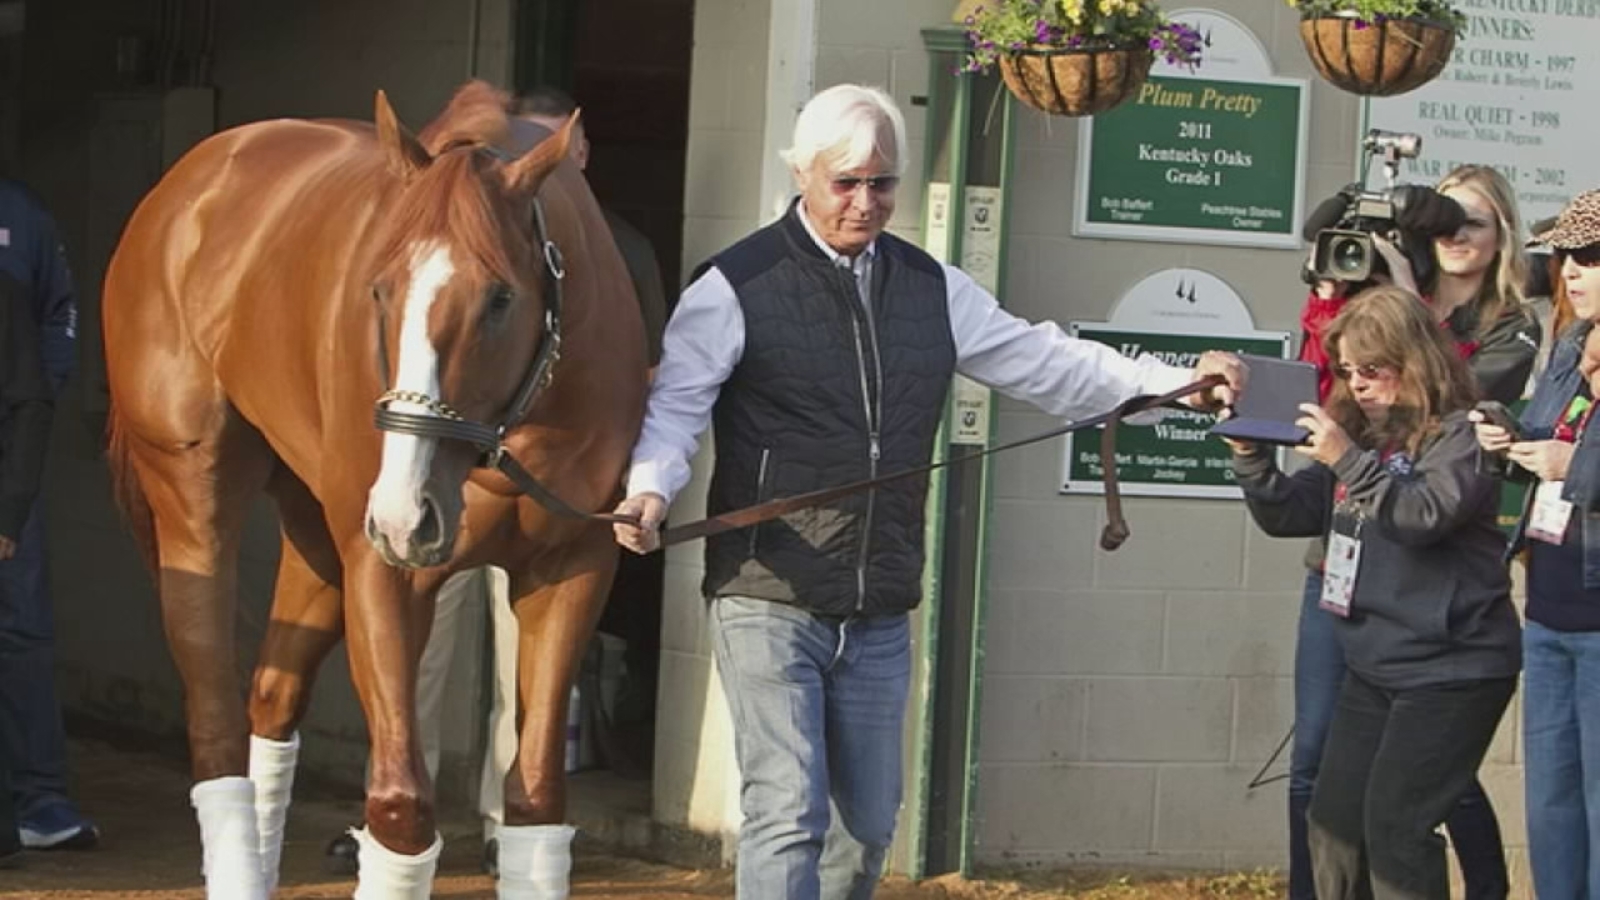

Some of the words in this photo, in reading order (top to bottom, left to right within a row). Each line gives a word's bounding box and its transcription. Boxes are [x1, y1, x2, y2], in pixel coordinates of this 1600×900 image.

[1554, 0, 1600, 18] DERB
[1470, 16, 1536, 41] INNERS:
[1469, 49, 1529, 69] CHARM
[1547, 55, 1576, 72] 1997
[1137, 83, 1194, 108] Plum
[1200, 87, 1263, 118] Pretty
[1418, 101, 1457, 121] REAL
[1464, 105, 1513, 127] QUIET
[1532, 111, 1561, 128] 1998
[1178, 121, 1212, 140] 2011
[1138, 143, 1209, 168] Kentucky
[1214, 148, 1253, 167] Oaks
[1165, 168, 1211, 187] Grade
[1406, 158, 1441, 177] WAR
[1535, 166, 1566, 186] 2002
[1154, 424, 1208, 441] Winner
